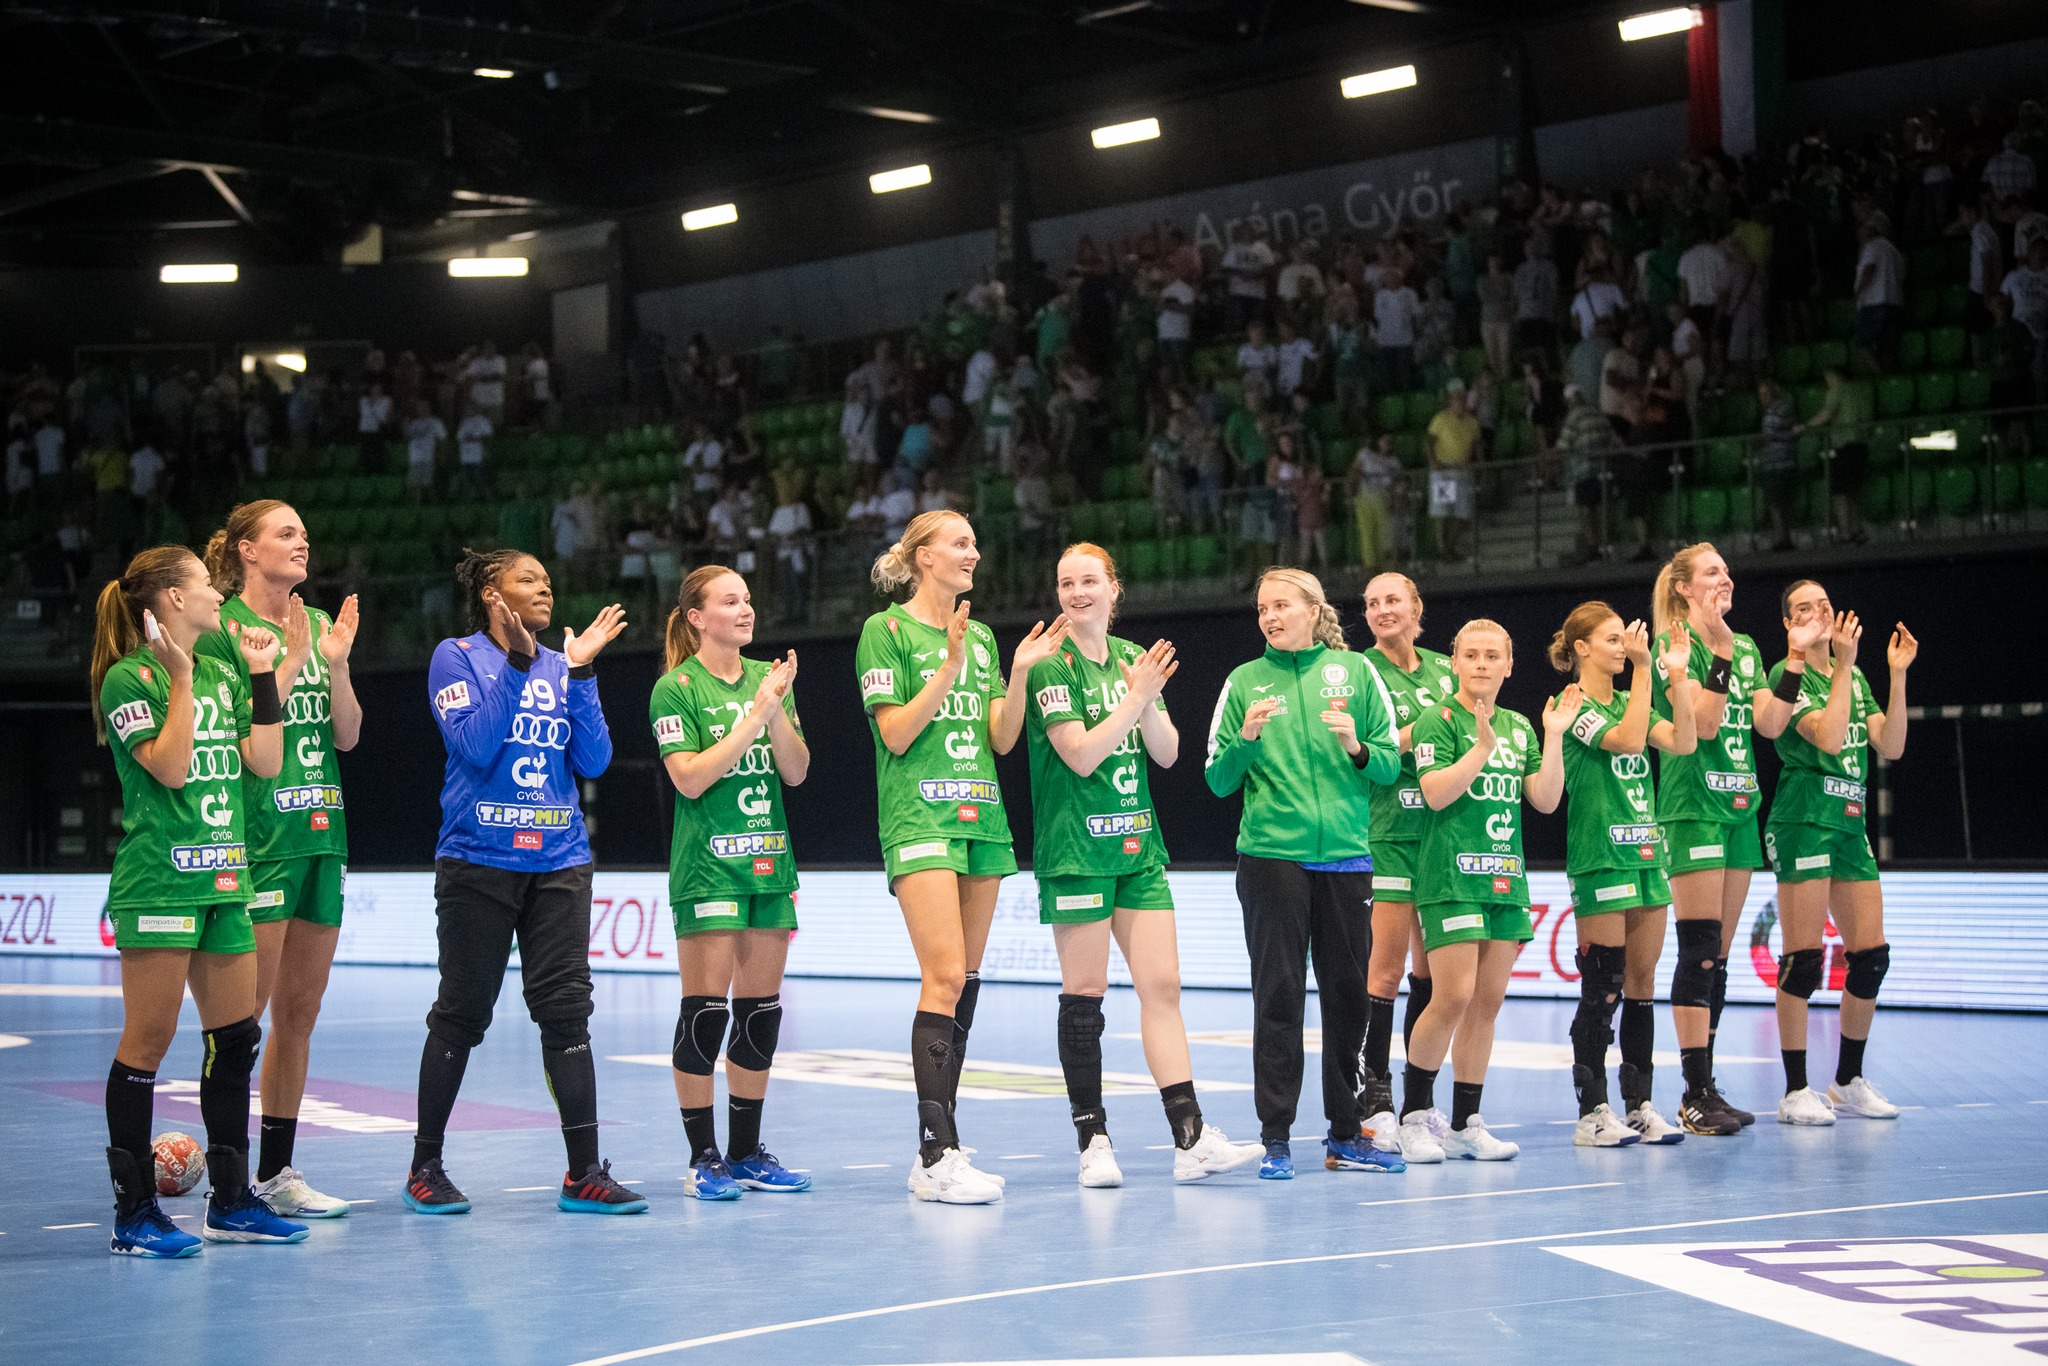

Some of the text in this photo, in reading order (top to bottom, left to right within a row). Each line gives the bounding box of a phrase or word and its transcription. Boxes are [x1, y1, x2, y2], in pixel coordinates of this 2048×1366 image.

[863, 671, 891, 690] OIL!
[1040, 687, 1068, 707] OIL!
[114, 703, 150, 730] OIL!
[193, 697, 225, 740] 22
[961, 809, 976, 817] TCL
[315, 817, 329, 825] TC
[518, 835, 538, 844] TCL
[1125, 841, 1138, 849] TCL
[756, 862, 771, 870] TCL
[218, 877, 235, 885] TCL
[1495, 881, 1507, 889] TCL
[140, 918, 182, 926] szimpatika
[156, 1144, 186, 1176] SELEC
